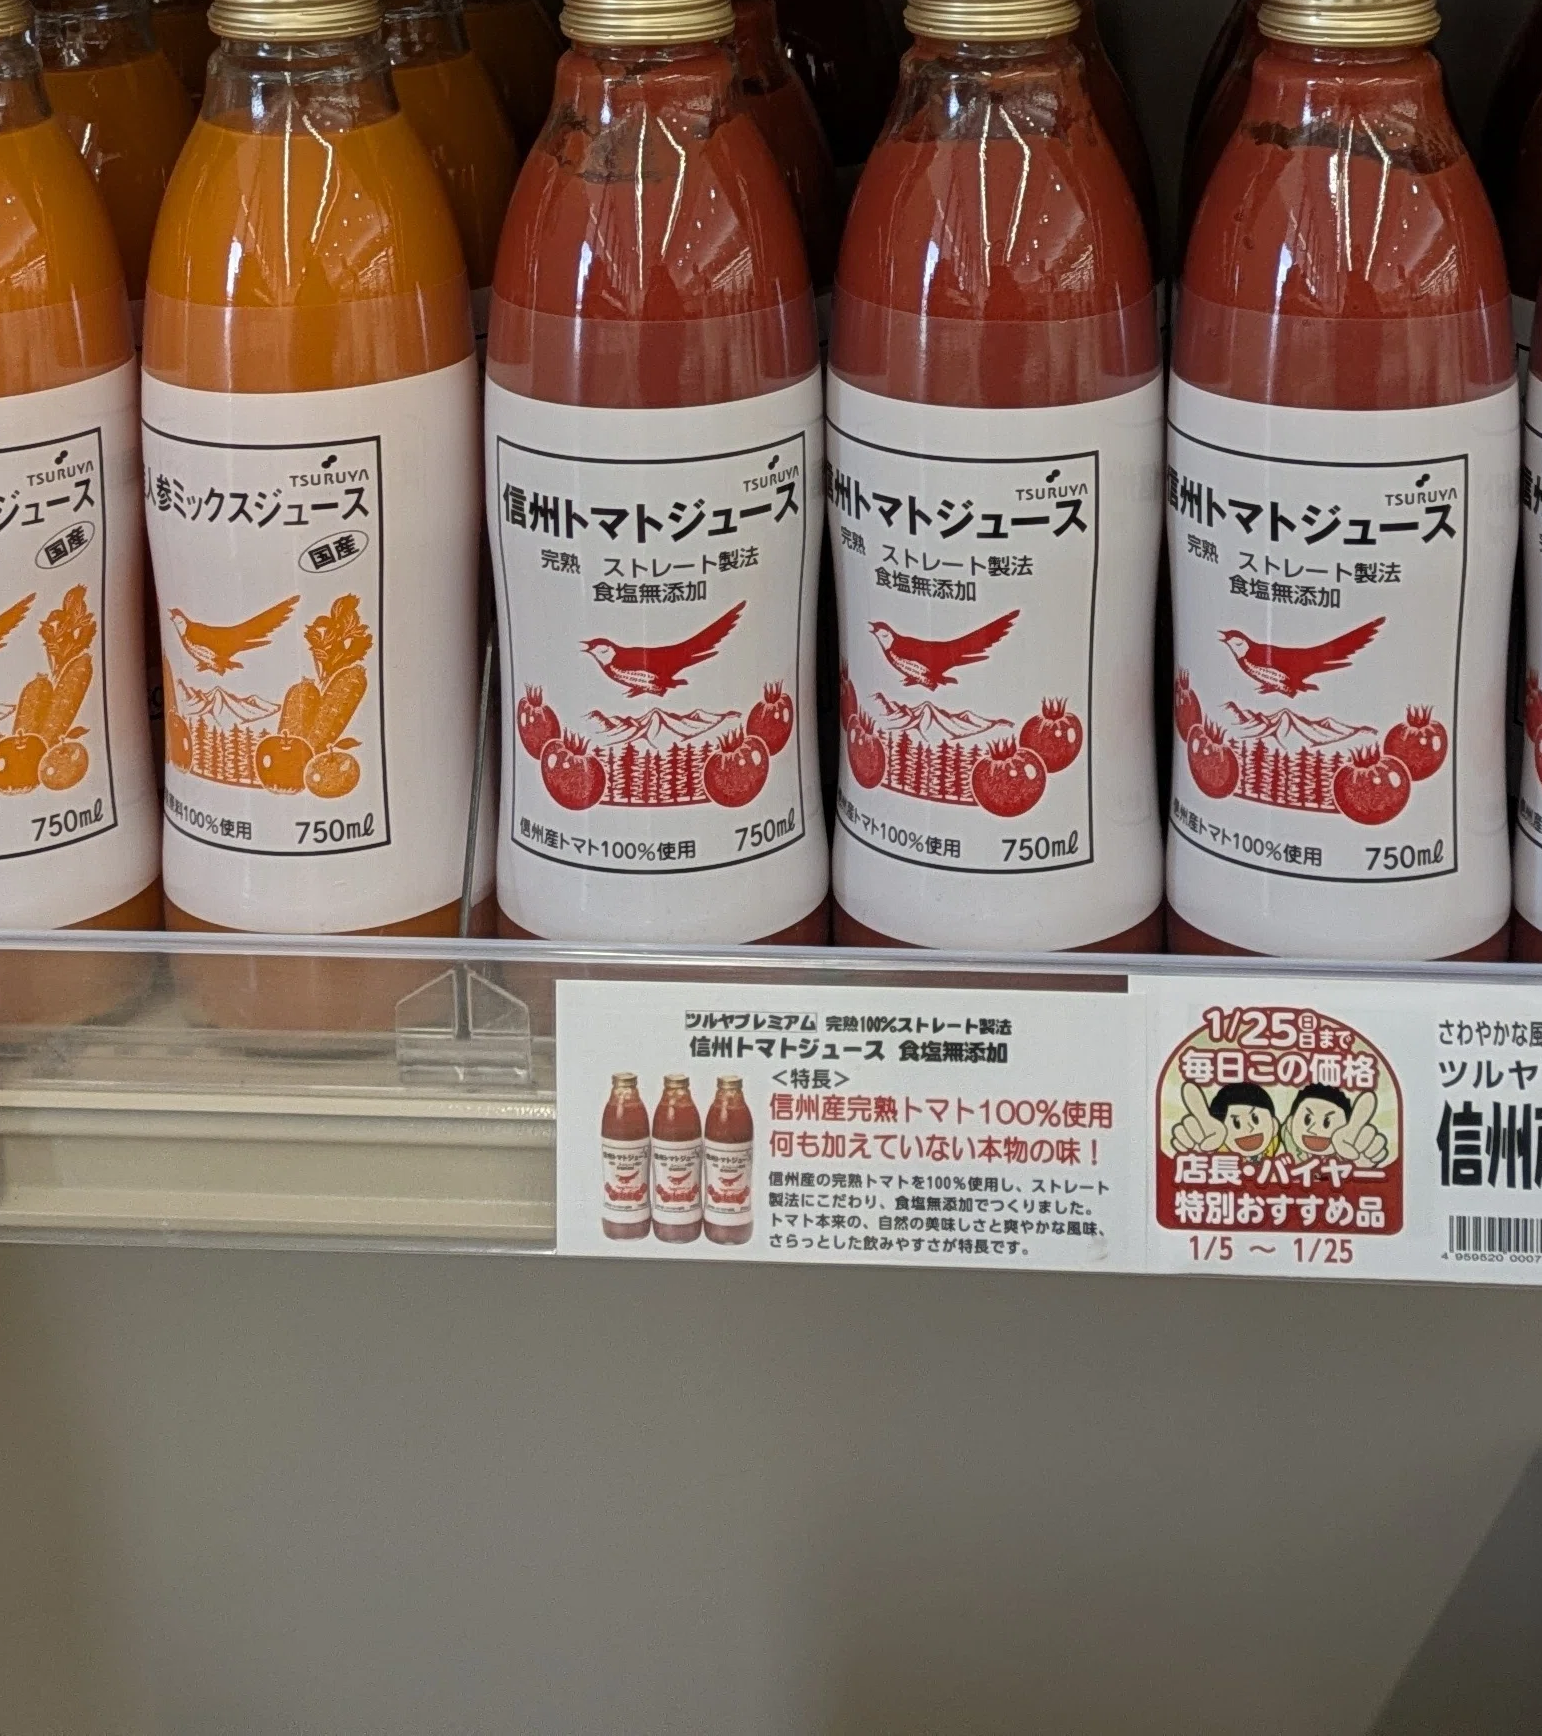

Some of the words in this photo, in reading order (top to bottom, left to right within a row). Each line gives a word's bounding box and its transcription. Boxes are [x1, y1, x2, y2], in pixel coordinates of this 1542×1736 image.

[27, 460, 94, 487] TSURUYA
[289, 469, 369, 488] TSURUYA
[742, 465, 799, 493] TSURUYA
[1015, 483, 1088, 501] TSURUYA
[1385, 488, 1458, 507] TSURUYA
[503, 482, 799, 543] 信州トマトジュース
[44, 525, 89, 565] 国産
[307, 533, 360, 570] 国産
[841, 526, 866, 555] 完熟
[882, 545, 1033, 577] ストレート製法
[1187, 534, 1219, 563] 完熟
[1238, 552, 1401, 584] ストレート製法
[541, 549, 581, 575] 完熟
[603, 547, 759, 578] ストレート製法
[593, 581, 707, 603] 食塩無添加
[874, 567, 977, 601] 食塩無添加
[1229, 574, 1341, 608] 食塩無添加
[520, 817, 696, 861] 信州産トマト100%使用
[686, 1011, 816, 1031] ツルヤプレミアム
[825, 1015, 1012, 1036] 完熟100%ストレート製法
[689, 1037, 885, 1062] 信州トマトジュース
[898, 1041, 1008, 1064] 食塩無添加
[1181, 1051, 1375, 1088] 毎日この価格
[769, 1093, 1113, 1130] 信州産完熟トマト100%使用
[769, 1171, 1109, 1195] 信州産の完熟トマトを100%使用し、ストレート
[1175, 1155, 1385, 1188] 店長・バイヤー
[769, 1193, 1093, 1217] 製法にこだわり、食塩無添加でつくりました。
[1175, 1190, 1385, 1228] 特別おすすめ品
[770, 1213, 1107, 1238] トマト本来の、自然の美味しさと爽やかな風味、
[769, 1233, 1030, 1256] さらっとした飲みやすさが特長です。
